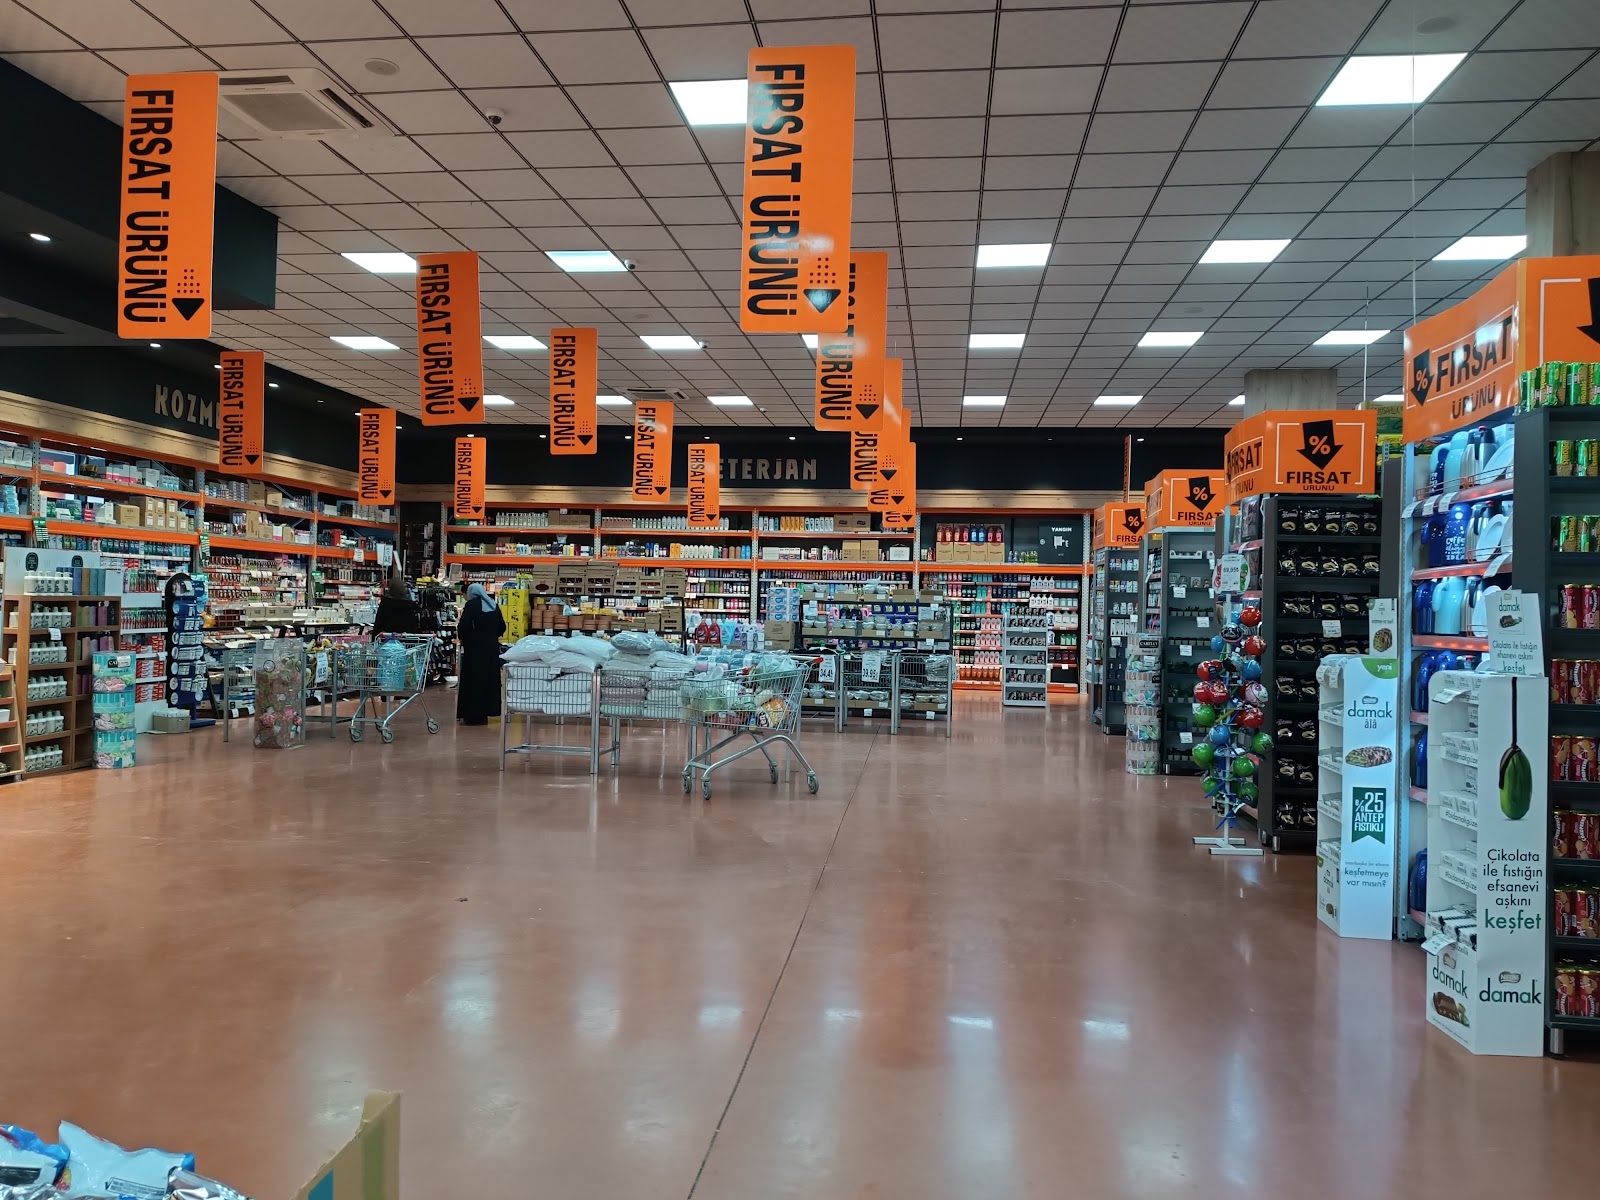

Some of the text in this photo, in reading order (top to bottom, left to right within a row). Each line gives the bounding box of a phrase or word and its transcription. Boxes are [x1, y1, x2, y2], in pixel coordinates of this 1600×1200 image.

[747, 64, 805, 316] FIRSAT ÜRÜNÜ
[123, 90, 174, 323] FIRSAT ÜRÜNÜ
[420, 263, 455, 415] FIRSAT ÜRÜNÜ
[1436, 314, 1513, 393] FIRSAT
[553, 335, 576, 447] FIRSAT ÜRÜNÜ
[221, 358, 244, 466] FIRSAT ÜRÜNÜ
[361, 413, 379, 500] FIRSAT ÜRÜNÜ
[634, 407, 656, 496] FIRSAT ÜRÜNÜ
[456, 442, 472, 515] FIRSAT ÜRÜNÜ
[690, 448, 705, 522] FIRSAT ÜRÜNÜ
[1286, 471, 1352, 484] FIRSAT
[1498, 597, 1521, 612] damak
[1377, 662, 1392, 672] yeni
[1347, 700, 1393, 719] damak
[1354, 813, 1384, 823] ANTEP
[1354, 822, 1384, 833] FISTIKLI
[1487, 848, 1540, 864] Çikolata
[1344, 867, 1389, 879] keşfetmeye
[1483, 864, 1543, 881] ile fıstığın
[1487, 879, 1539, 892] efsanevi
[1495, 893, 1531, 909] aşkını
[1485, 908, 1542, 935] keşfet
[1432, 955, 1469, 999] damak
[1478, 977, 1542, 1005] damak
